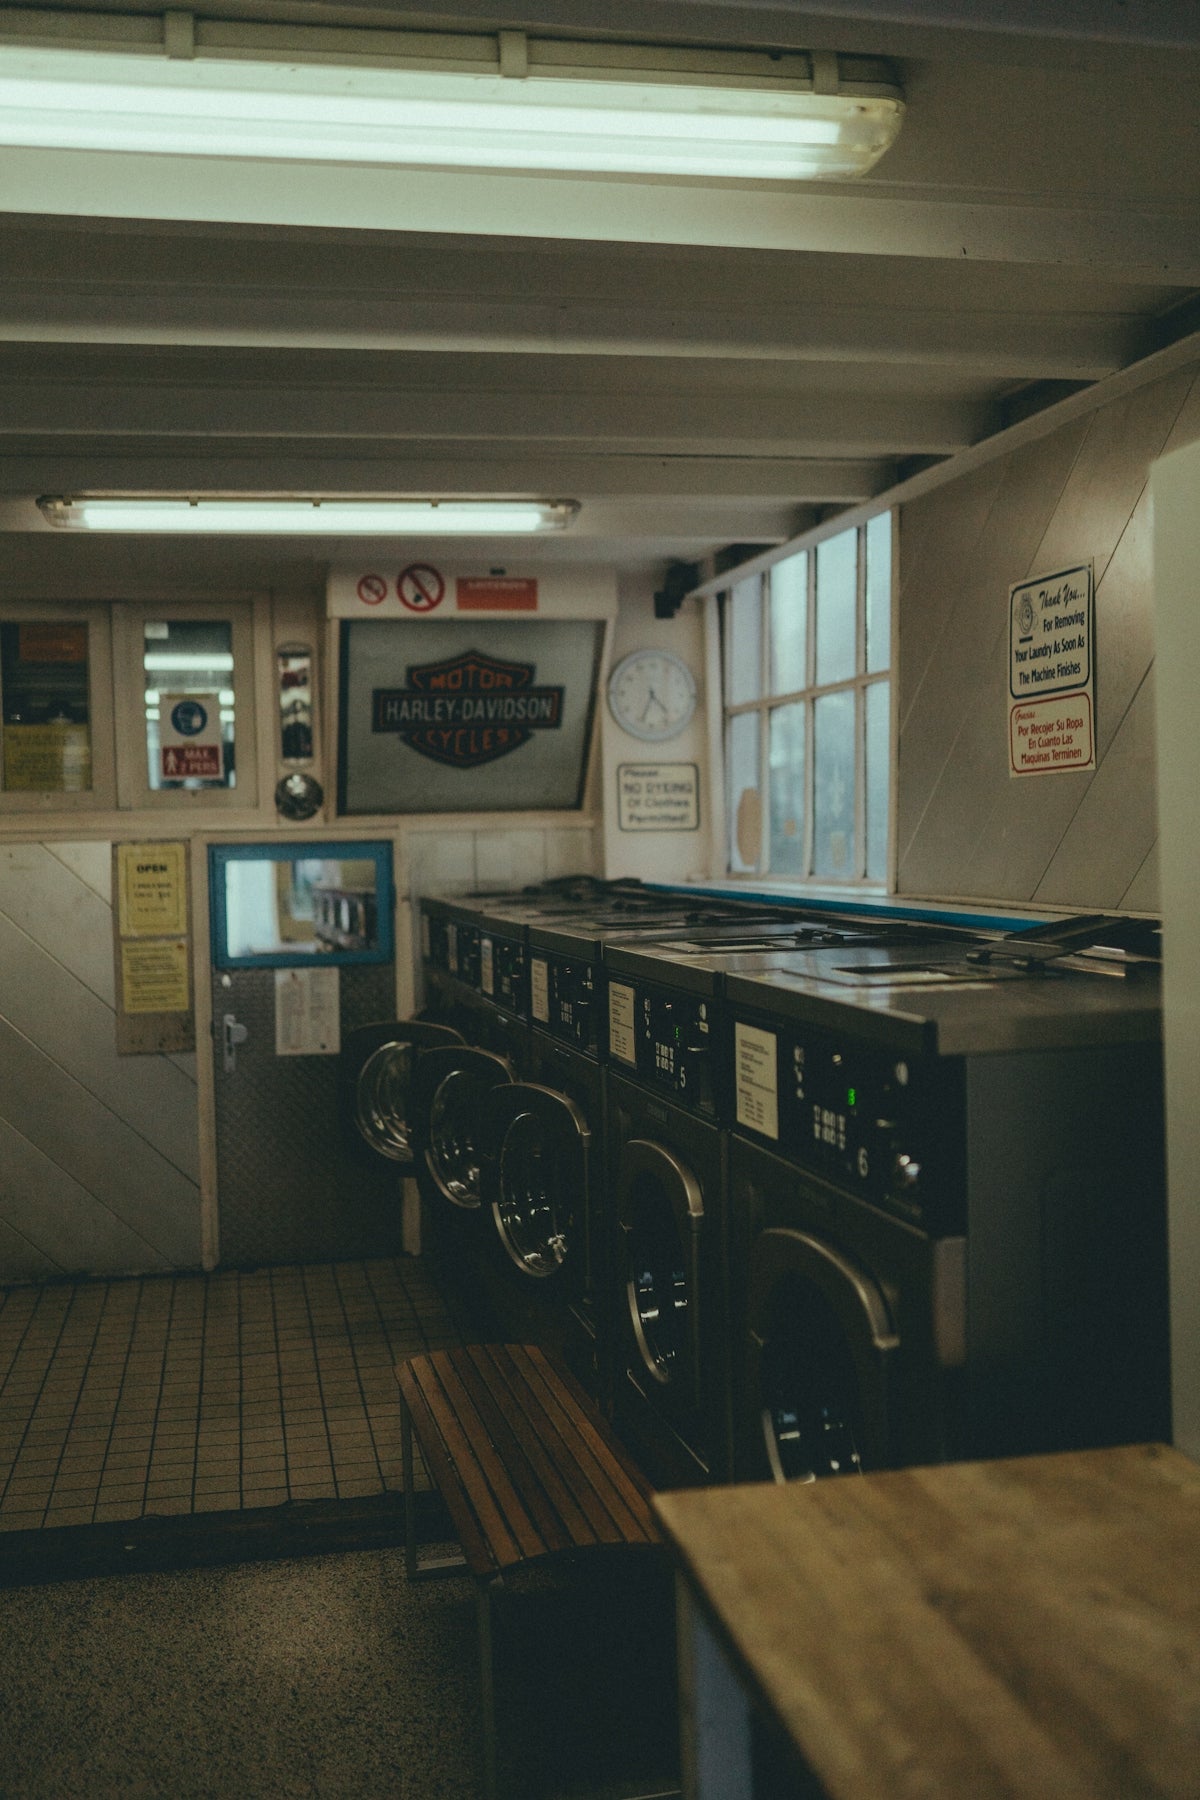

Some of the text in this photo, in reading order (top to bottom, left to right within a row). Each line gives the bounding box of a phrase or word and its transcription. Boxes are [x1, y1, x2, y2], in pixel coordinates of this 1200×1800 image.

[1039, 590, 1061, 610] Thank
[1043, 609, 1085, 633] For Removing
[1015, 634, 1085, 663] Your Laundry As Soon As
[430, 663, 514, 690] MOTOR
[1019, 661, 1081, 686] The Machine Finishes
[1018, 716, 1084, 737] Por Recojer Su Ropa
[426, 727, 511, 755] CYCLES
[1028, 733, 1074, 749] En Cuanto Las
[1021, 747, 1083, 765] Maquinas Terminen
[624, 782, 642, 794] NO
[136, 863, 167, 873] OPEN
[680, 1066, 687, 1089] 5
[857, 1146, 869, 1178] 6
